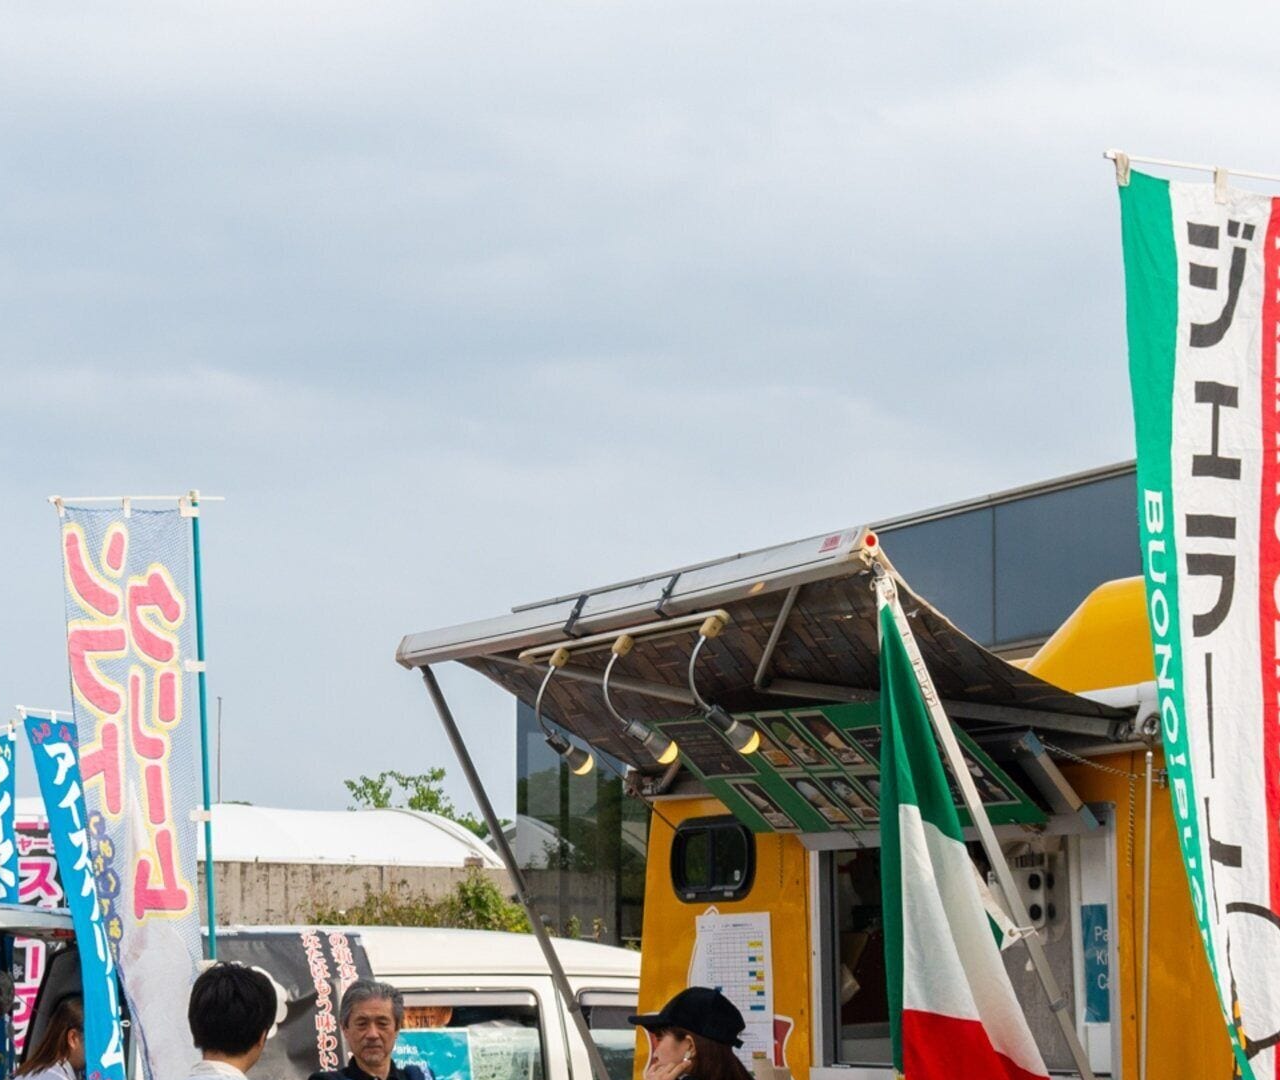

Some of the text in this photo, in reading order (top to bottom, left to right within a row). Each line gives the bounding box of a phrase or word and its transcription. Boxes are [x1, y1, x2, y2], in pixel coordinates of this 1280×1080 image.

[42, 742, 125, 1069] アイスクリーム
